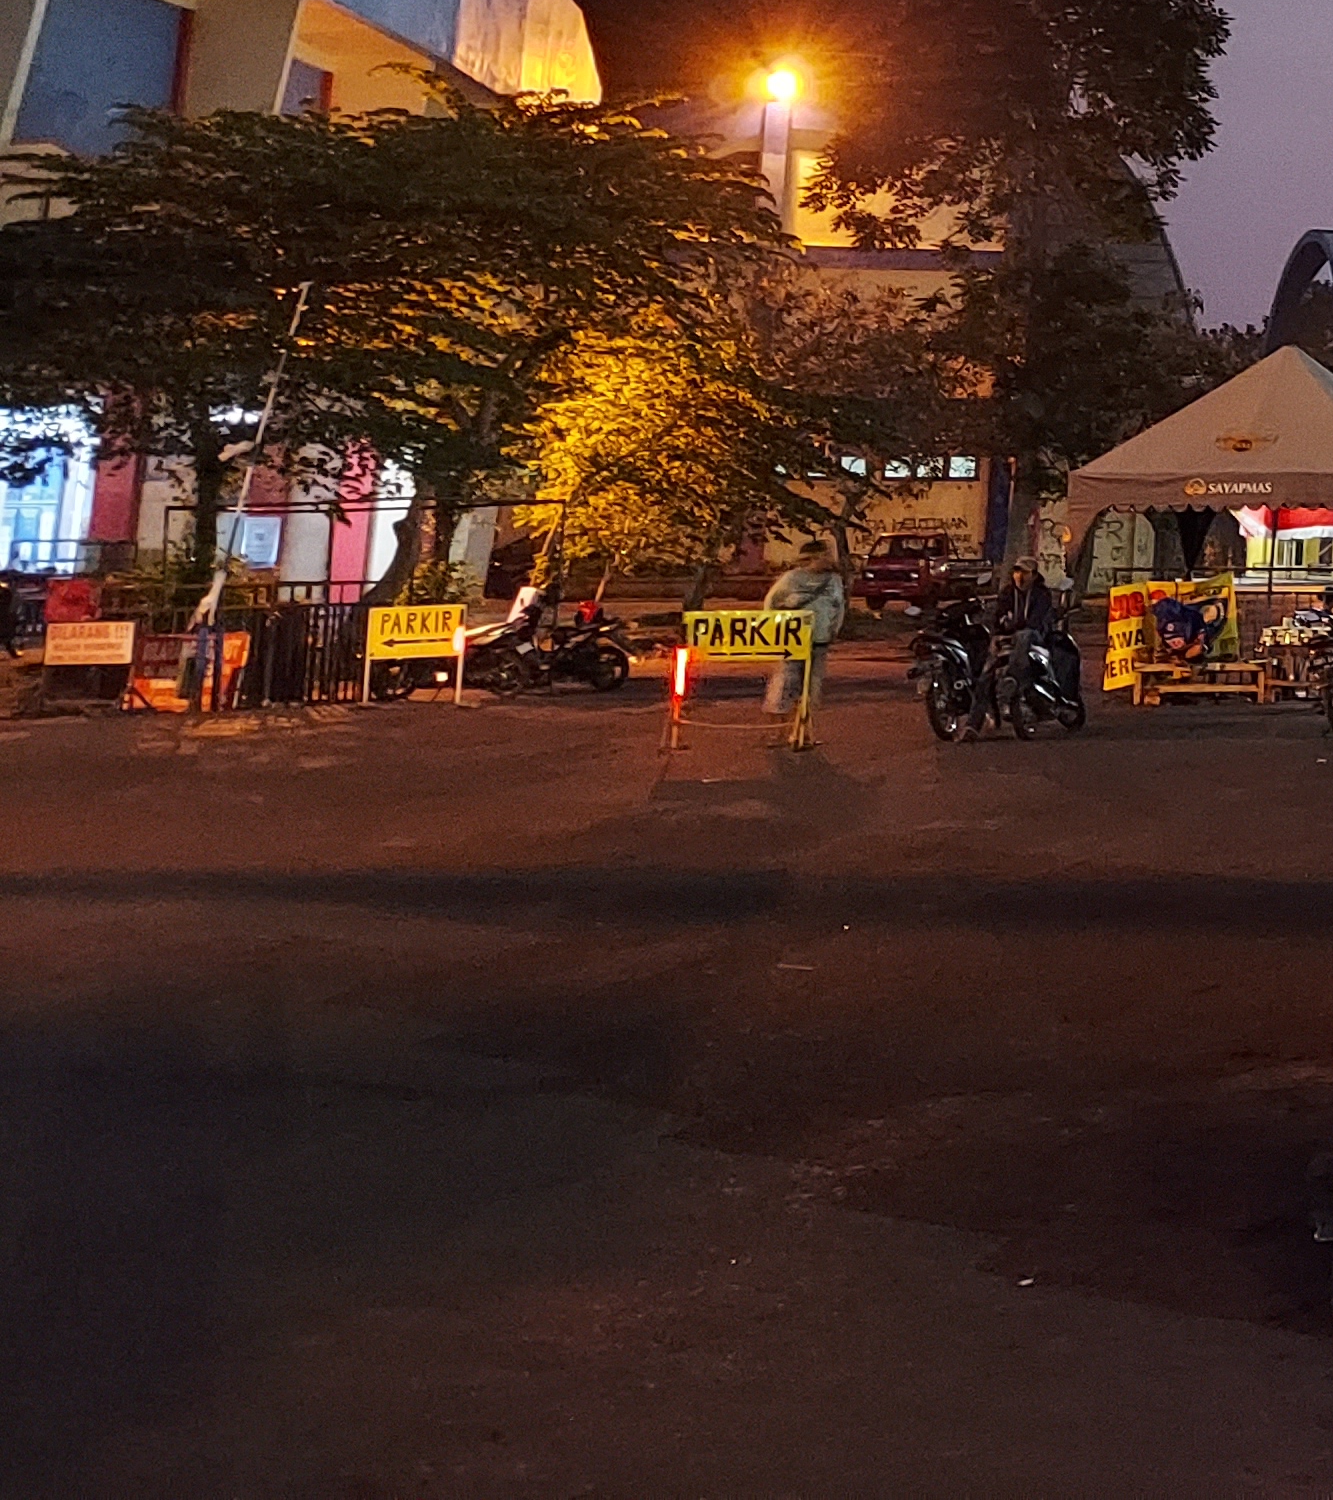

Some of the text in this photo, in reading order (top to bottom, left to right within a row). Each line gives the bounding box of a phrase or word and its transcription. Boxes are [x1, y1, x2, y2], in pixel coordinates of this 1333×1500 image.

[1207, 482, 1273, 495] SAYAPMAS
[380, 610, 453, 636] PARKIR
[693, 617, 802, 646] PARKIR
